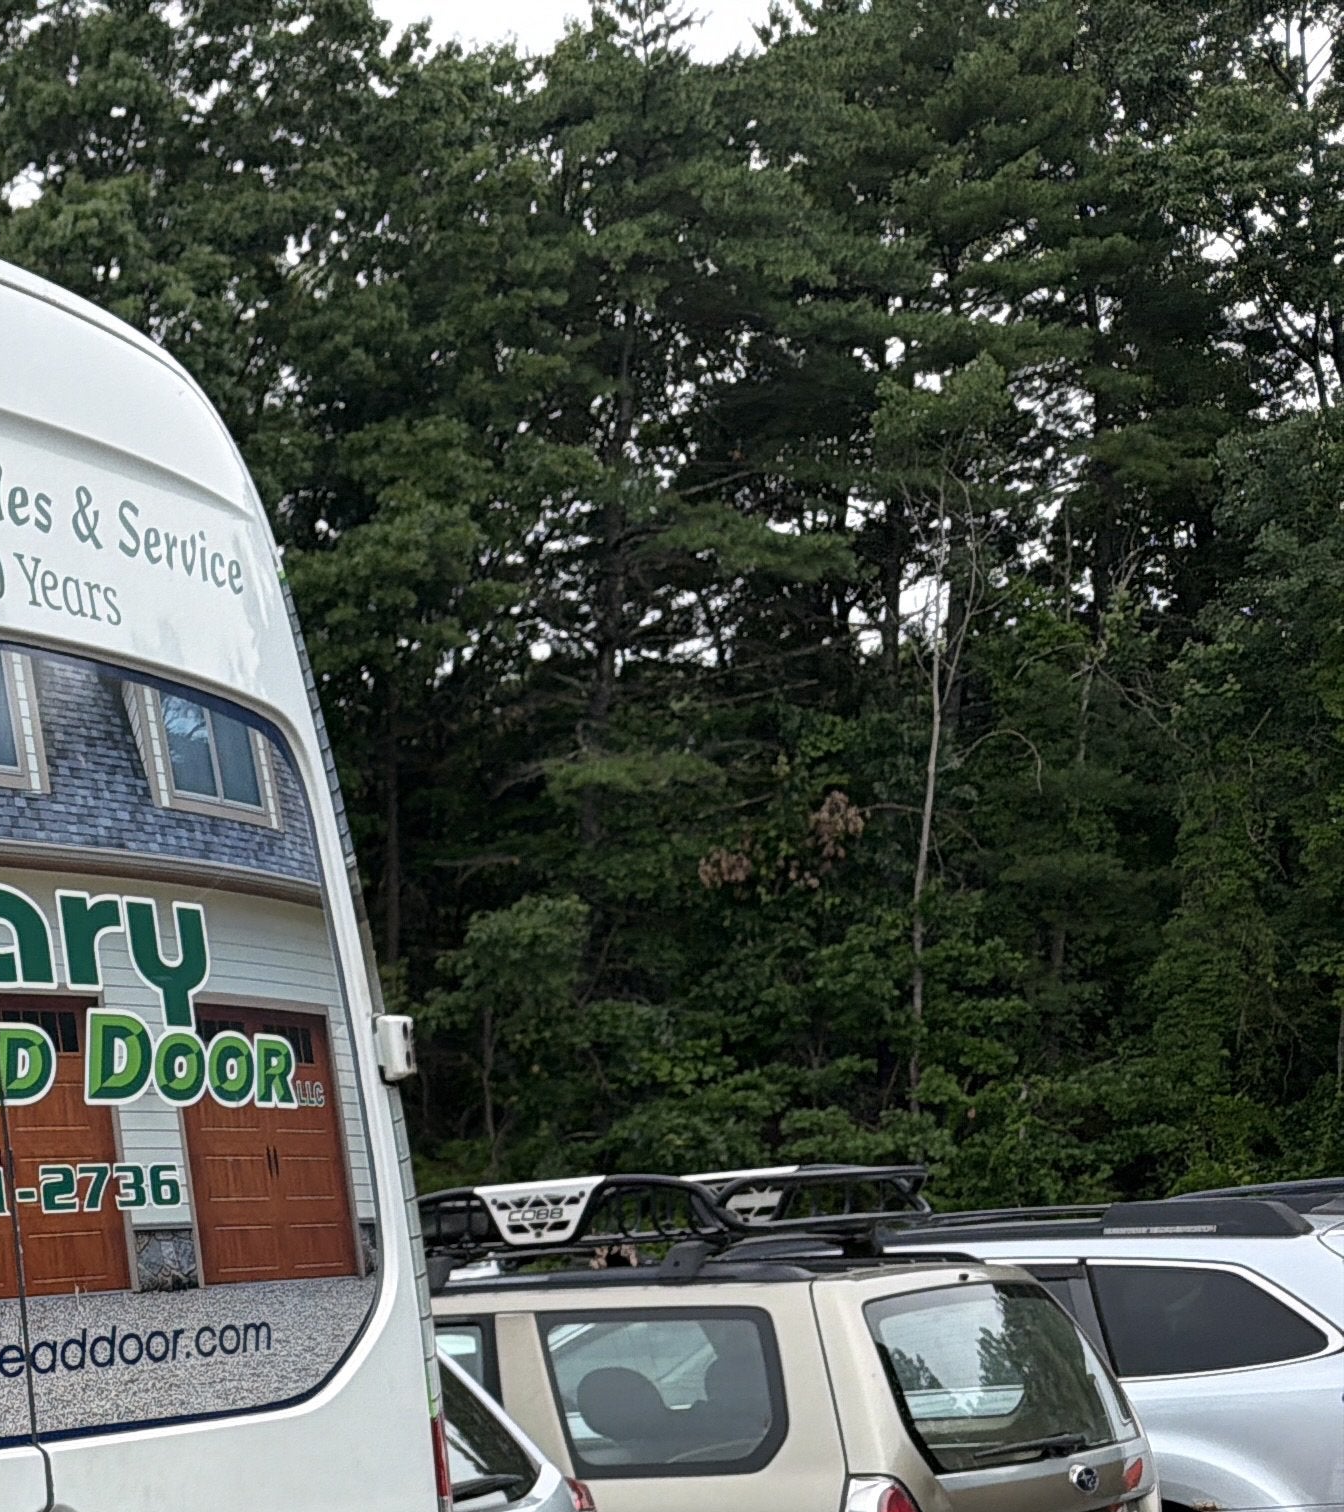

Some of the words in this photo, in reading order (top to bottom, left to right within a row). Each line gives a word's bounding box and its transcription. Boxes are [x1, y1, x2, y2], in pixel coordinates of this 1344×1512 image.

[13, 551, 122, 627] Years
[71, 484, 103, 549] &
[118, 499, 244, 596] Service
[84, 1008, 297, 1109] DOOR
[295, 1080, 325, 1108] LLC
